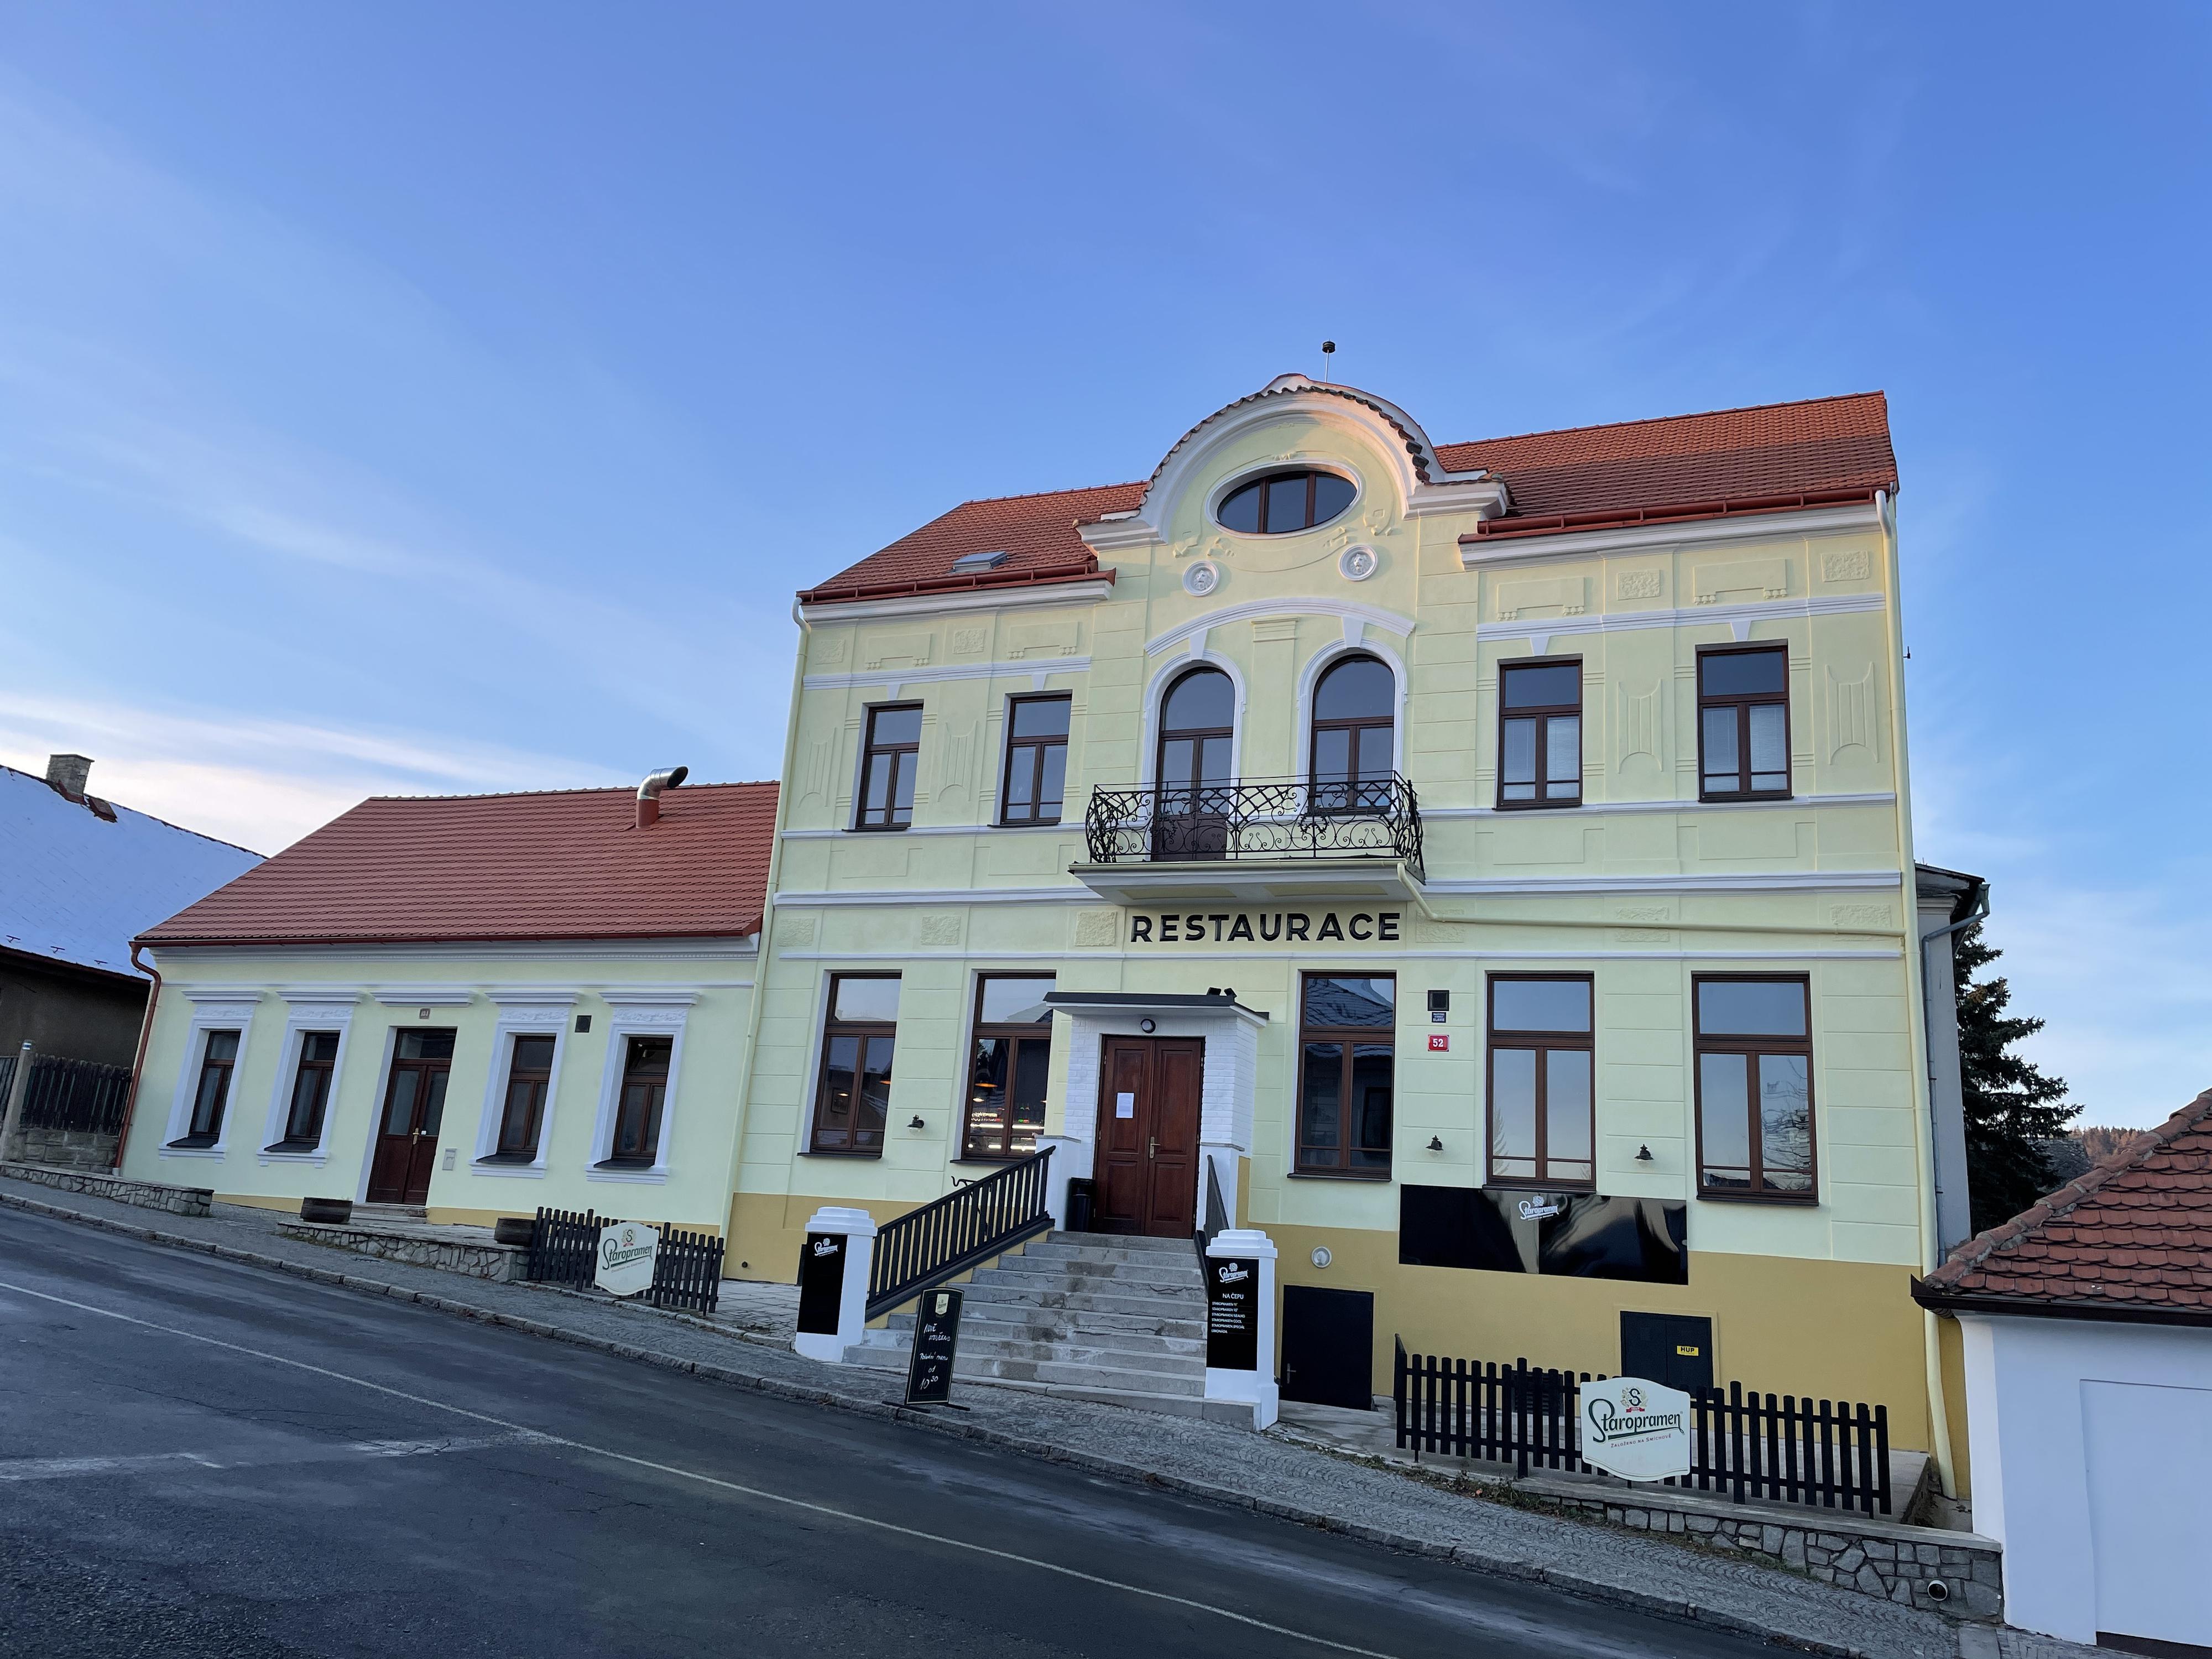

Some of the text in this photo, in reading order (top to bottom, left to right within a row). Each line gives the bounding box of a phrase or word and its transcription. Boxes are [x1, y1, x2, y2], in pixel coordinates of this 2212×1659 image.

[1131, 912, 1400, 942] RESTAURACE
[1433, 1038, 1443, 1047] 52
[1519, 1201, 1559, 1220] Staropramen
[602, 1238, 653, 1270] Staropramen
[1588, 1399, 1684, 1443] Staropramen
